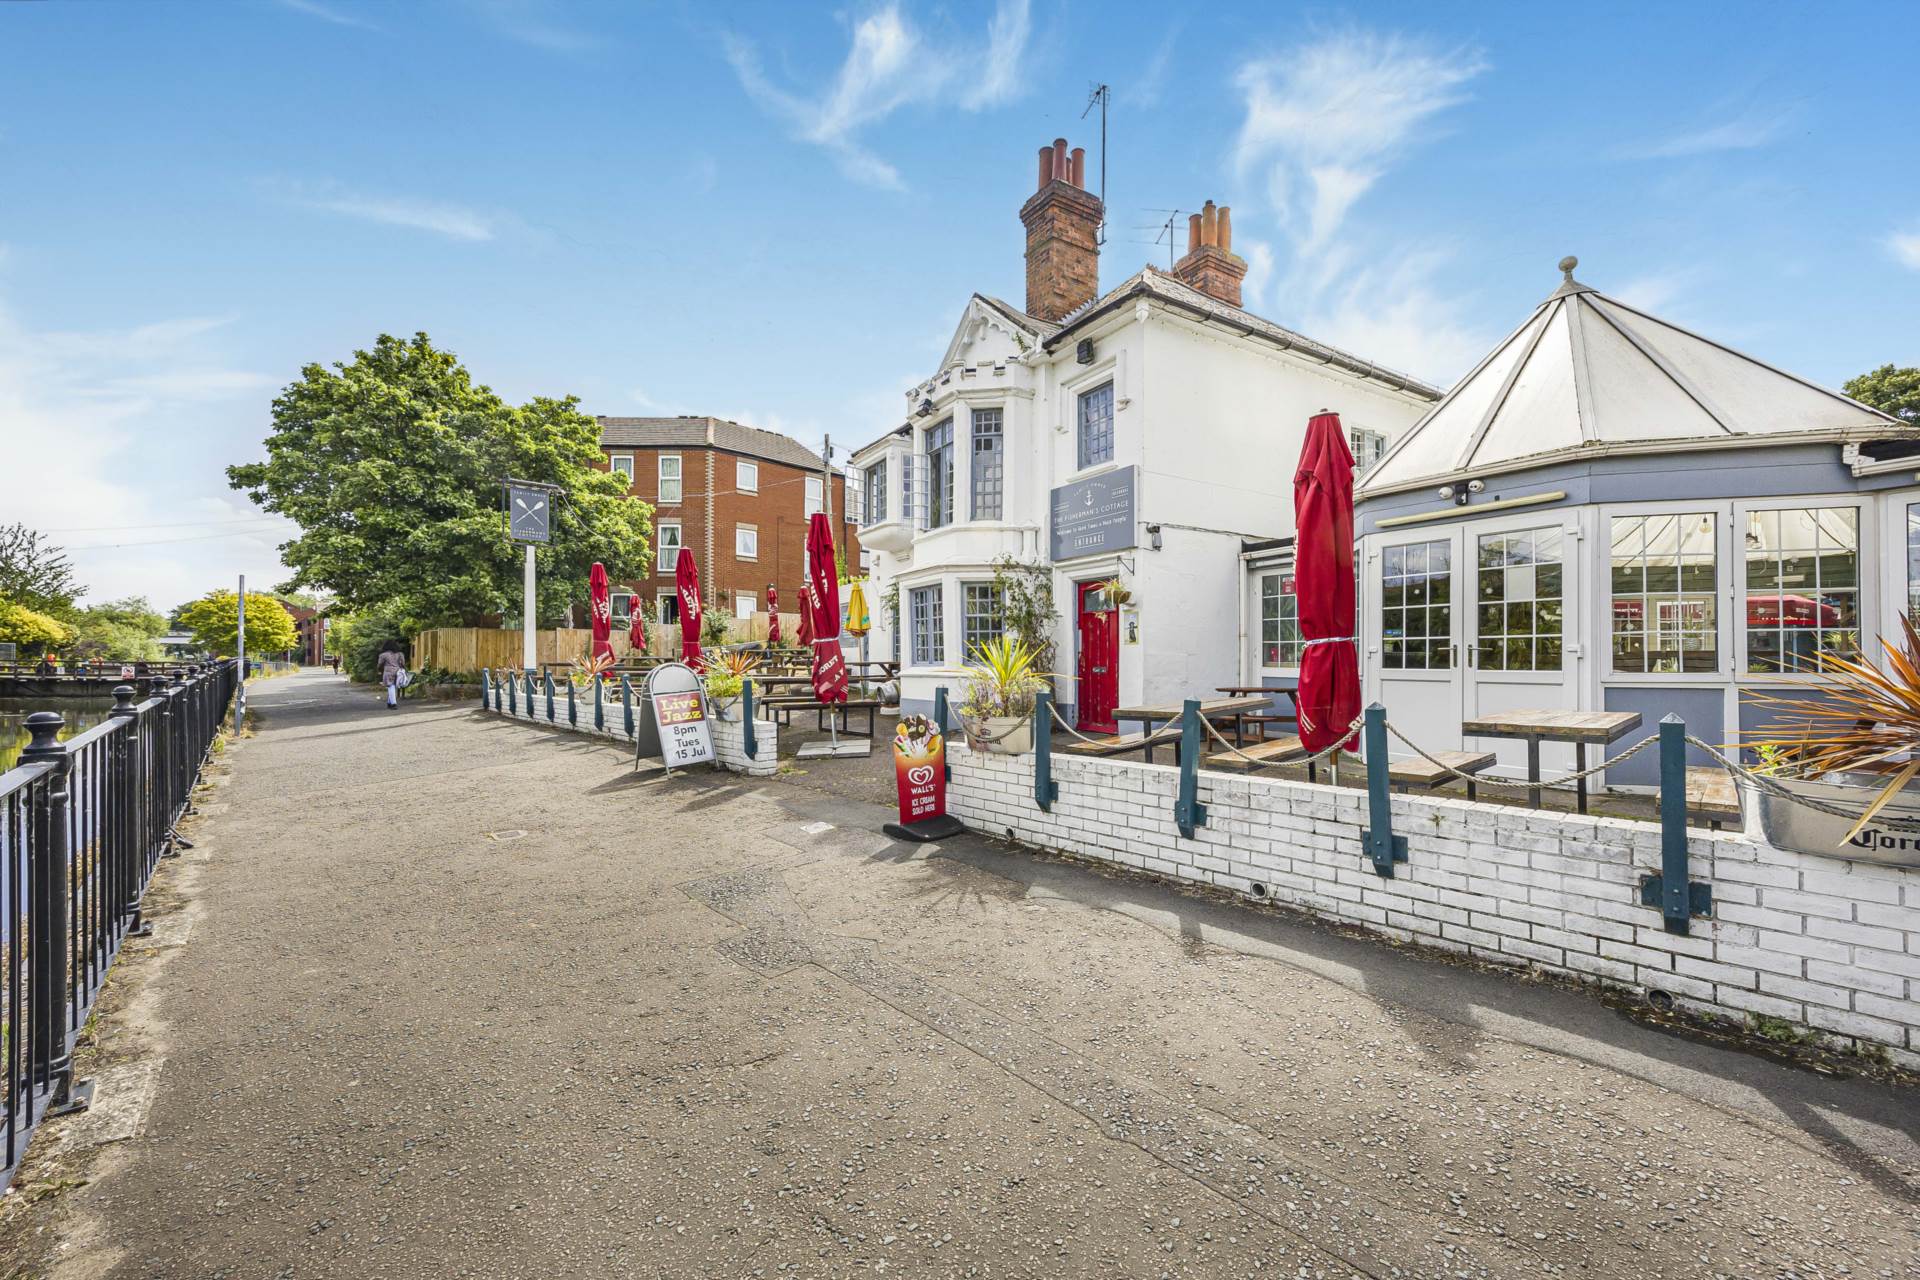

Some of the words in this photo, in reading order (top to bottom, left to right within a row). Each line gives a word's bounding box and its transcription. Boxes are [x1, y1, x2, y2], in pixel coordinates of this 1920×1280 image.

[1101, 500, 1129, 513] COTTAGE
[1074, 534, 1105, 547] ENTRANCE
[660, 699, 698, 711] Live
[662, 710, 701, 722] Jazz
[673, 725, 697, 736] 8pm
[675, 738, 700, 748] Tues
[676, 749, 688, 759] 15
[691, 746, 706, 757] Jul
[911, 784, 934, 794] WALL'S
[920, 795, 935, 805] CREAM
[912, 807, 924, 816] SOLD
[925, 804, 935, 812] HERE
